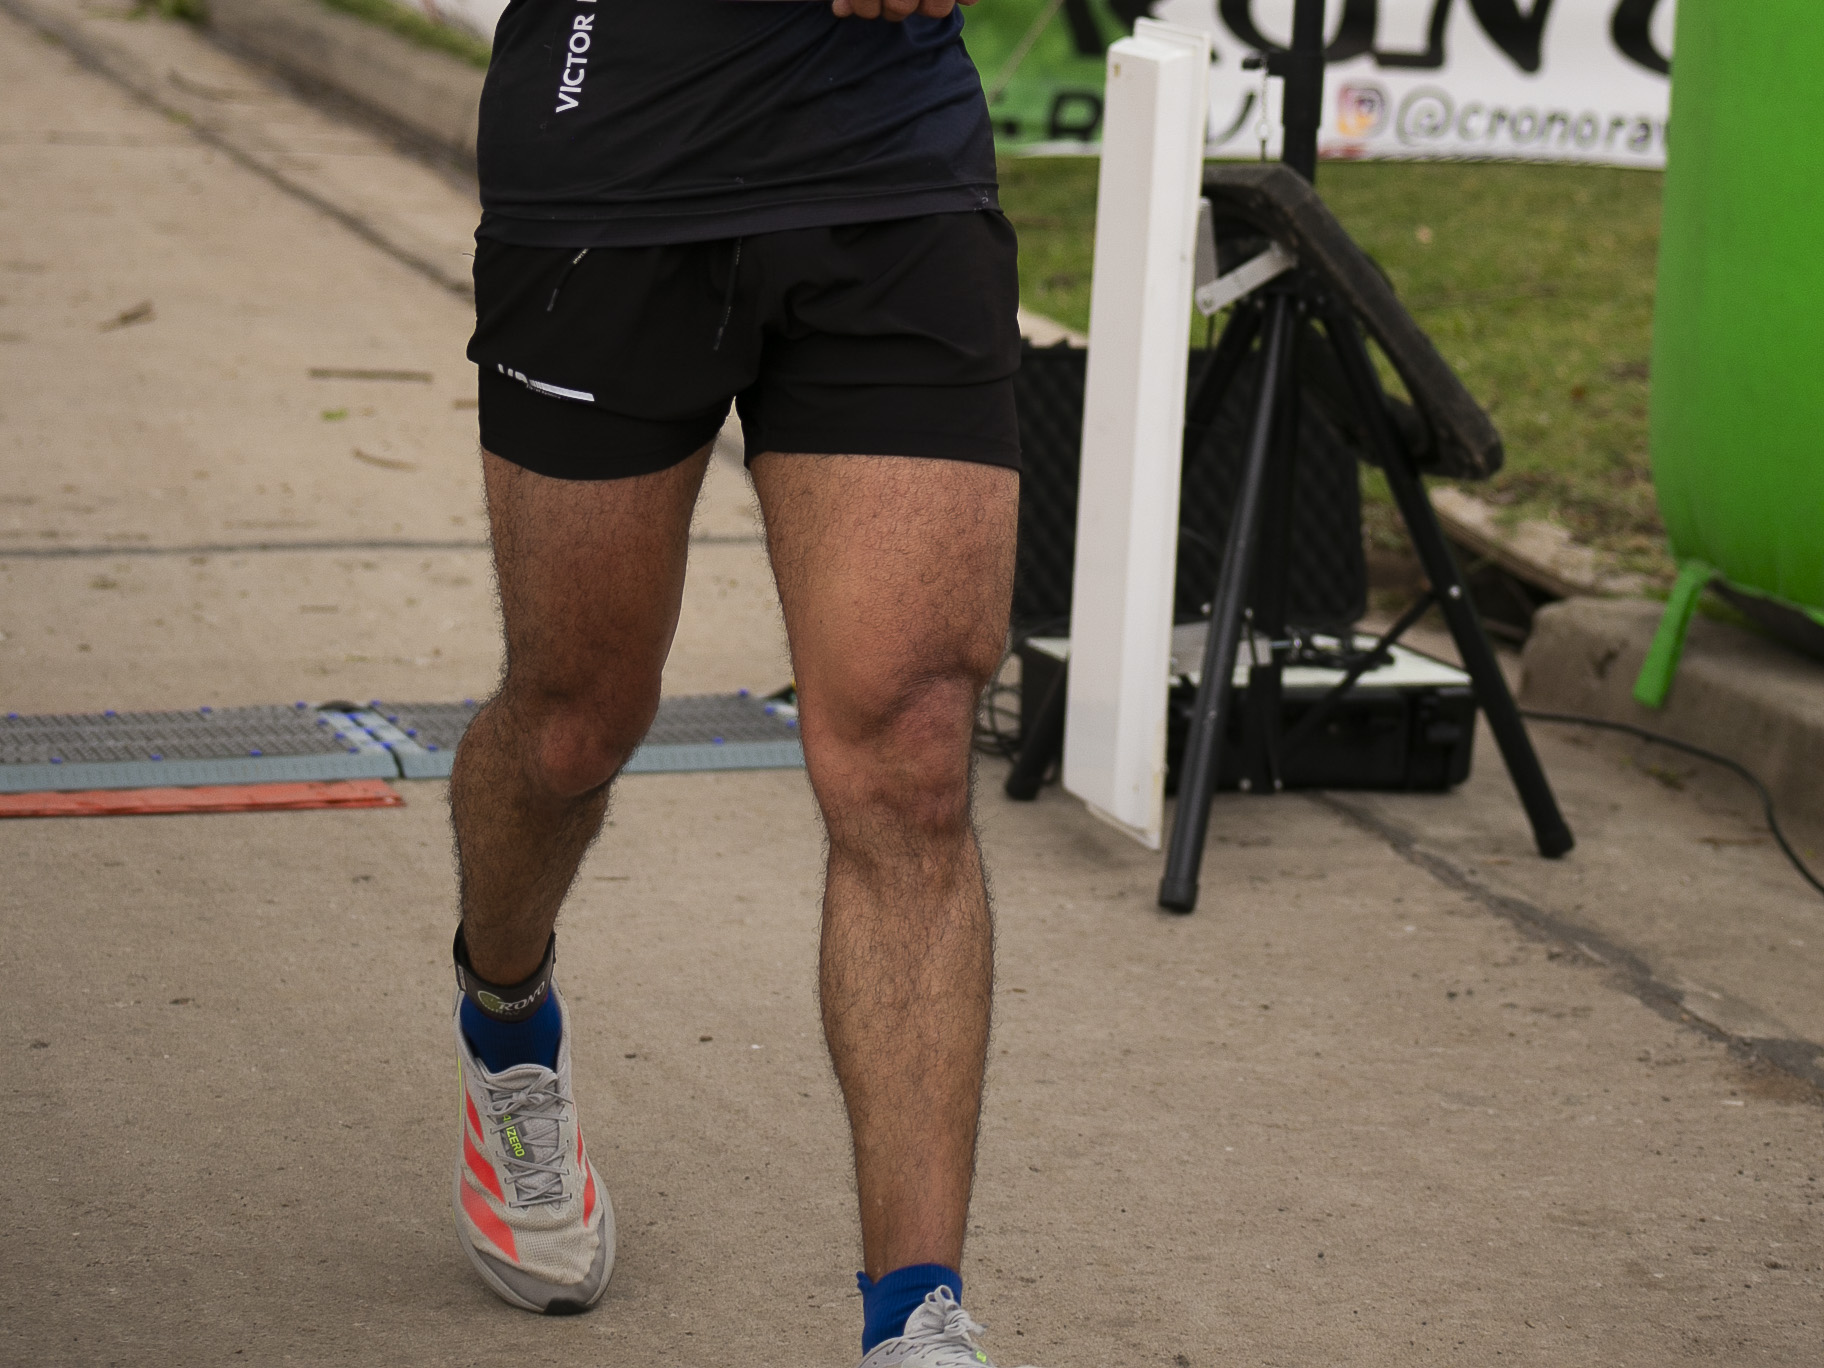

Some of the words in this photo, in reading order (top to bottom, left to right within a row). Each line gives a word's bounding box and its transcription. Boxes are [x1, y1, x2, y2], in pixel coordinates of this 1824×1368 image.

[556, 13, 596, 113] VICTOR
[1396, 85, 1666, 153] @cronora
[503, 1114, 525, 1157] AIZERO
